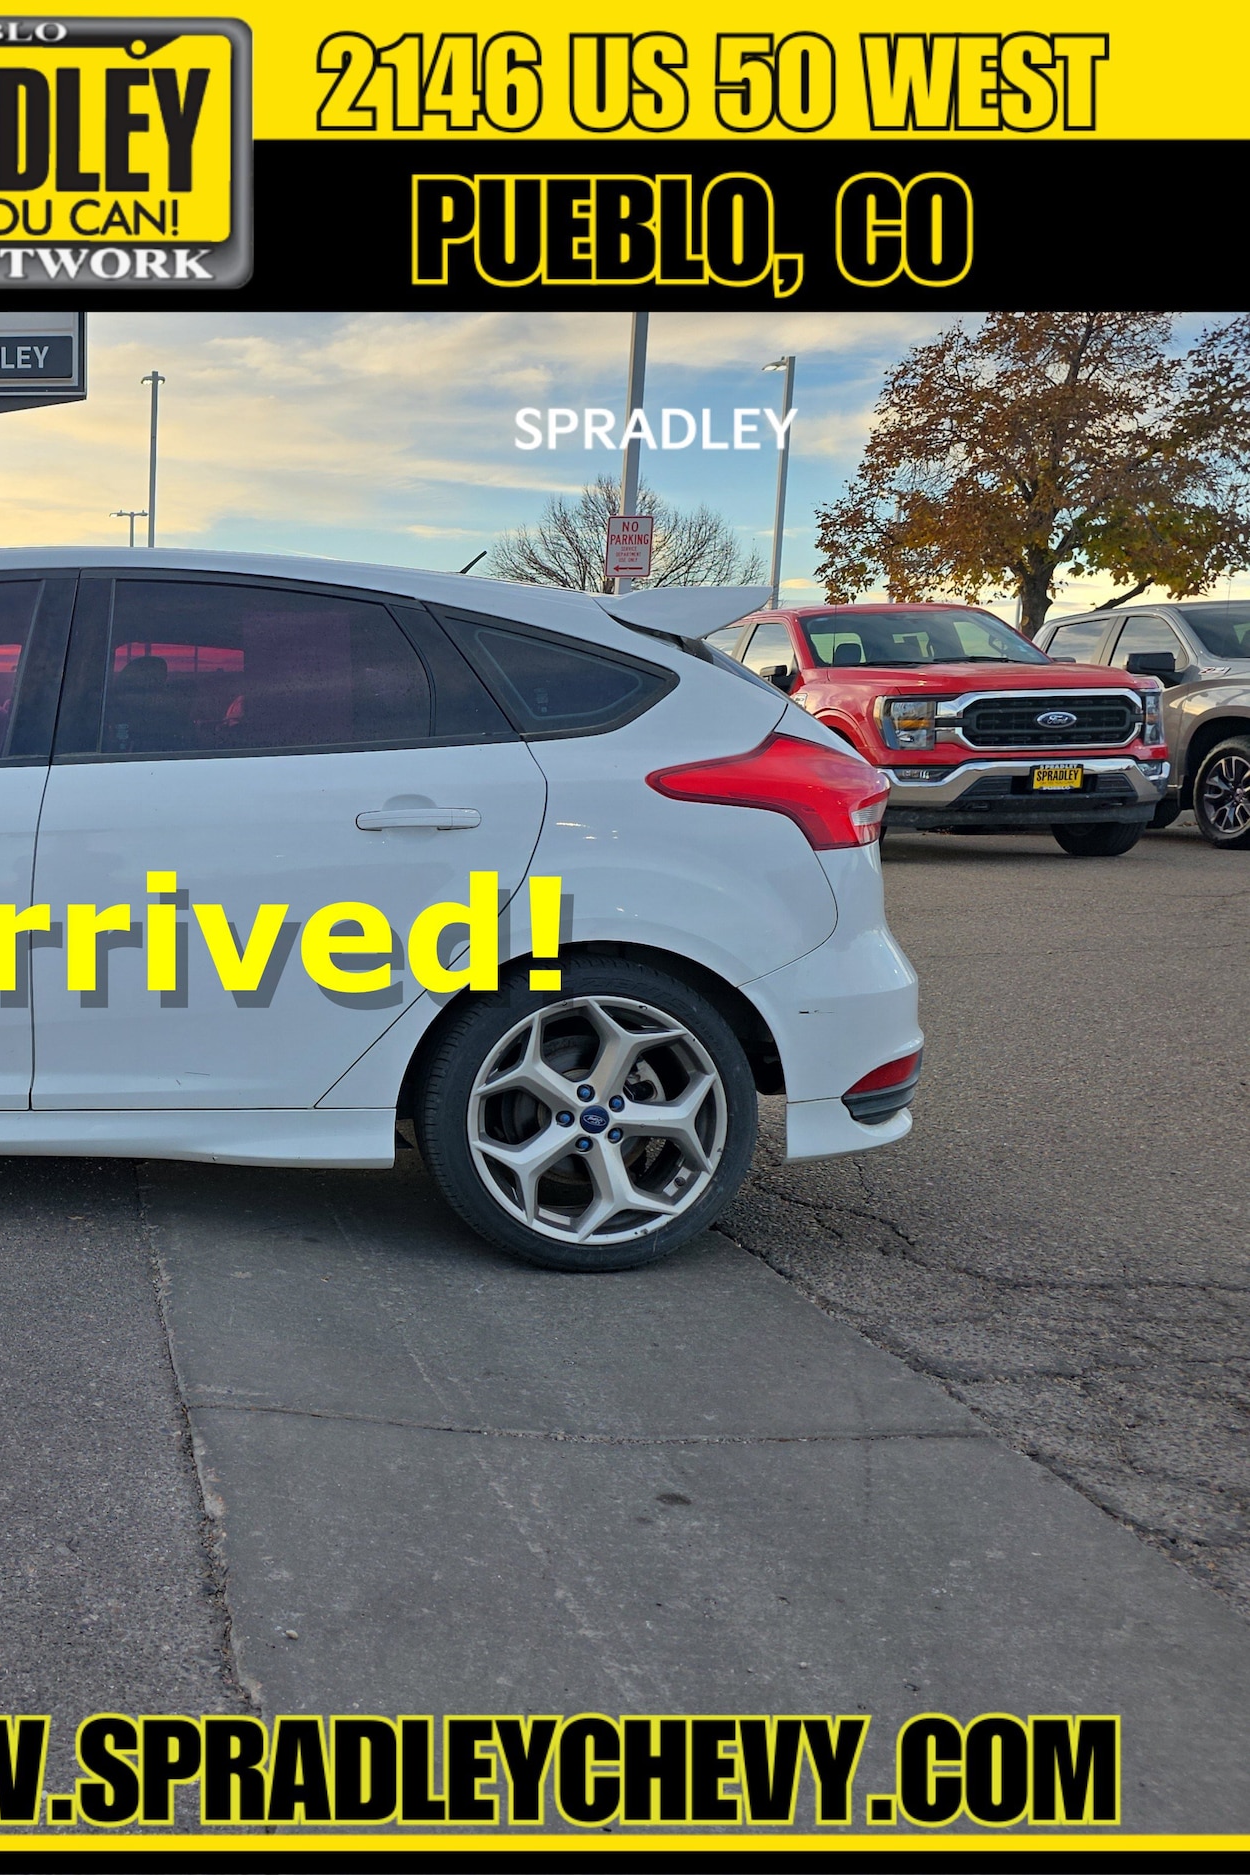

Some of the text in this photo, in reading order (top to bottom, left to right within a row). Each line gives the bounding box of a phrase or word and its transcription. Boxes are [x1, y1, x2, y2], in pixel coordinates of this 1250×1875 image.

[622, 521, 639, 532] NO
[610, 534, 649, 545] PARKING
[1036, 770, 1079, 781] SPRADLEY
